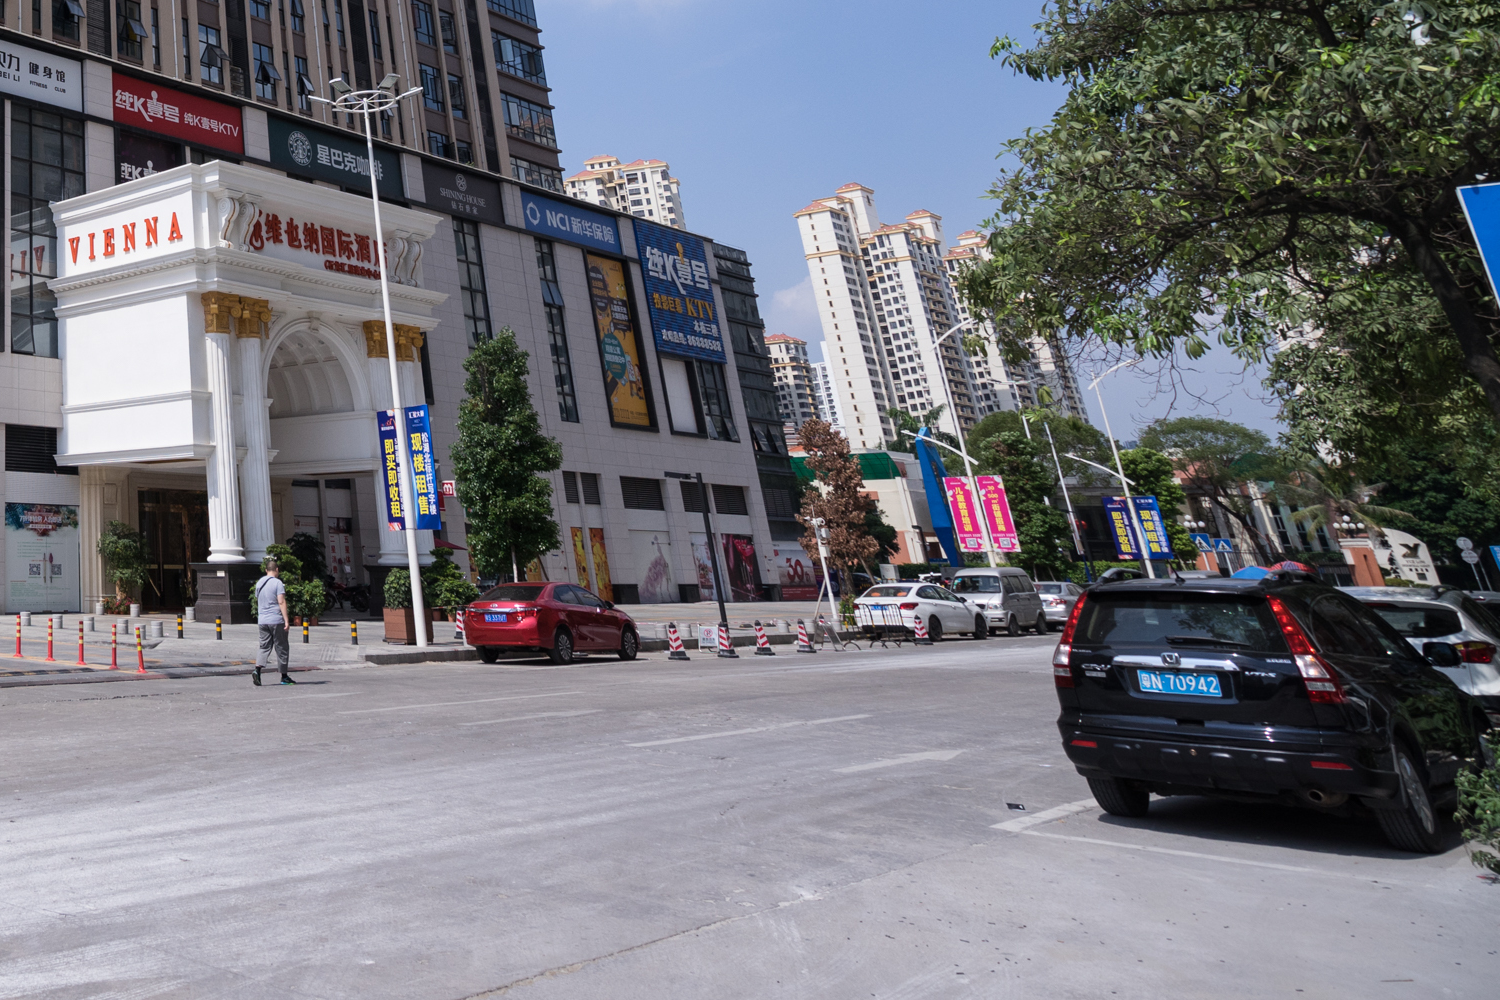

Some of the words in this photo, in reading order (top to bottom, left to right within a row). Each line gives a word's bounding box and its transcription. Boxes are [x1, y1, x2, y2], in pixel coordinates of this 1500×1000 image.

[13, 74, 20, 82] LI
[29, 62, 65, 83] 健身馆
[29, 80, 47, 89] FITNESS
[54, 86, 66, 94] CLUB
[115, 89, 179, 123] 纯K壹号
[184, 112, 239, 137] 纯K壹号KTV
[317, 144, 383, 180] 星巴克咖啡
[440, 187, 465, 202] SHINING
[466, 195, 486, 208] HOUSE
[69, 212, 183, 264] VIENNA
[265, 213, 388, 268] 维也纳国际酒店
[545, 210, 570, 232] NCI
[571, 217, 615, 244] 新华保险
[685, 297, 713, 321] KTV
[384, 439, 401, 517] 即买即收租
[411, 433, 429, 515] 现楼租售
